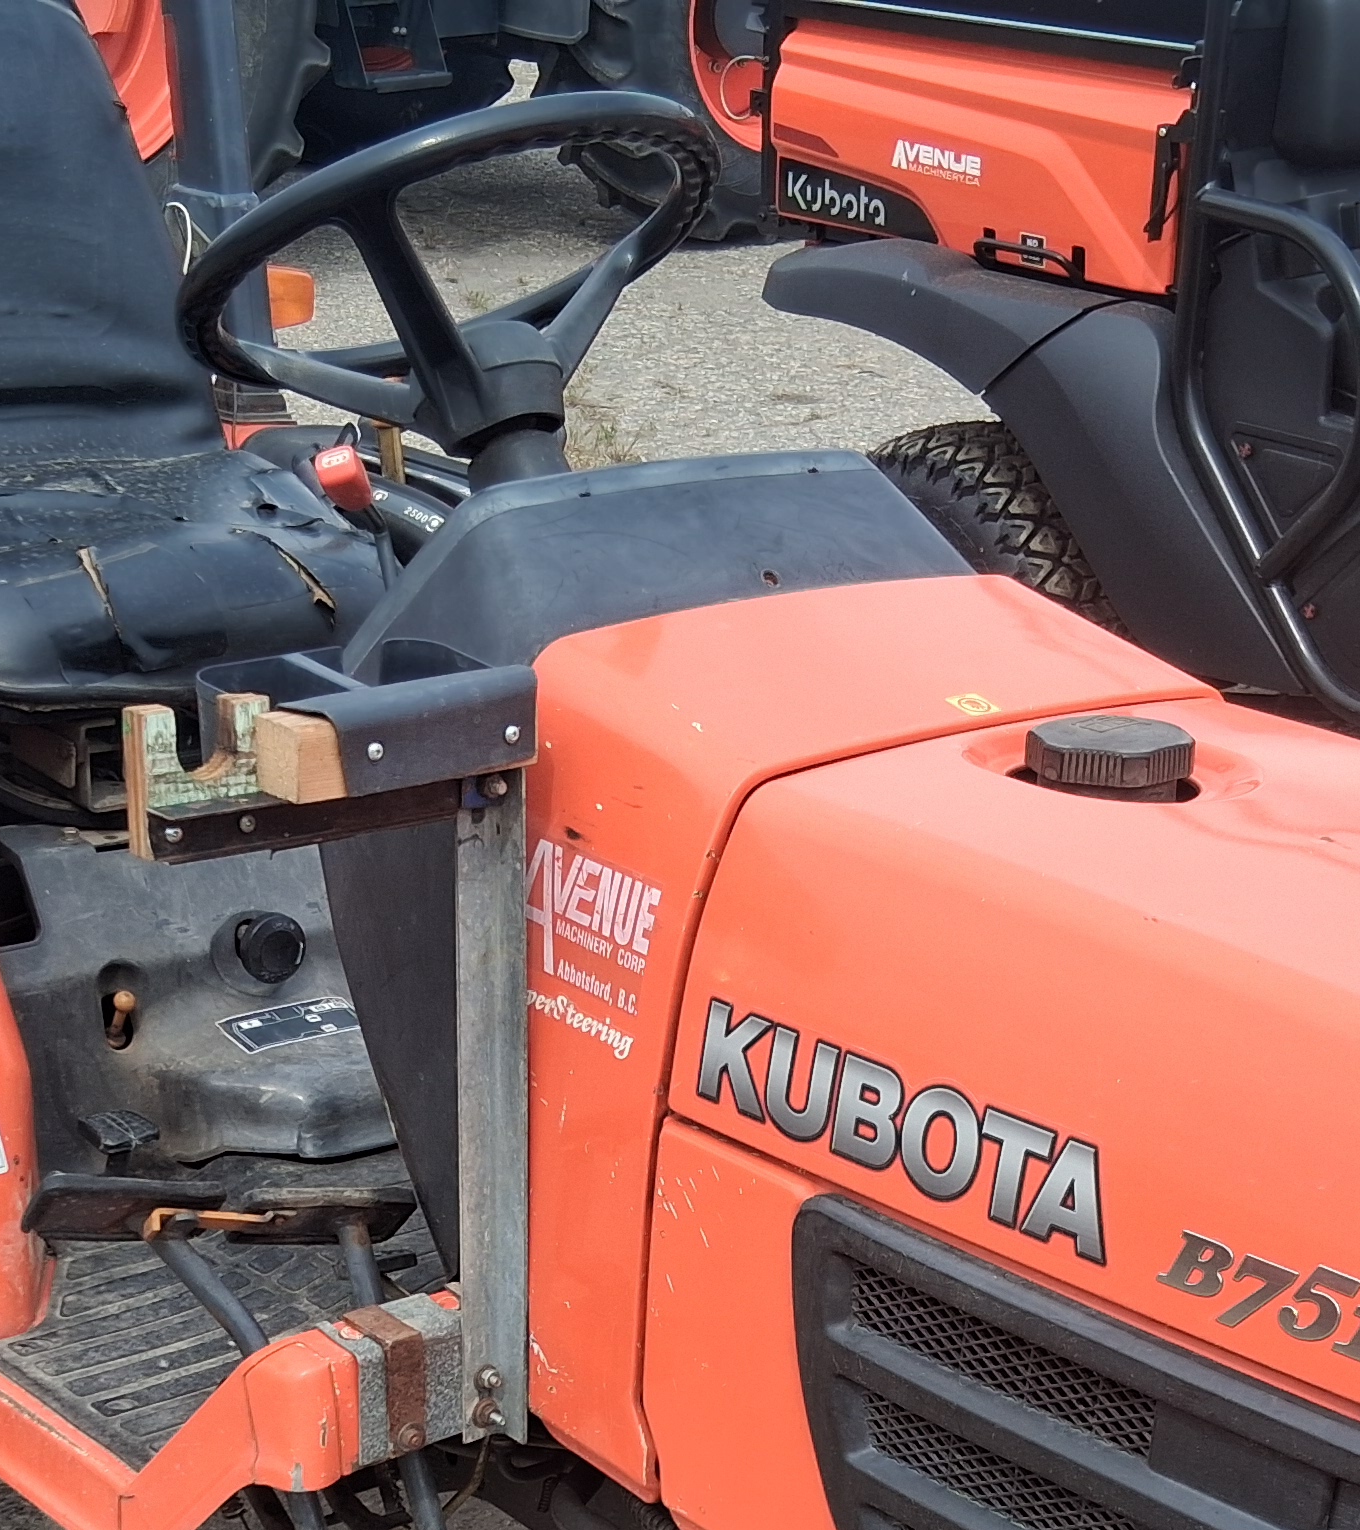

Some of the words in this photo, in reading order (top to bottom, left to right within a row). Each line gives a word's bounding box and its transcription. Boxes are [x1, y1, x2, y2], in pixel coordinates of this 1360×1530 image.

[891, 139, 981, 176] AVENUE
[908, 163, 981, 187] MACHINERY.CA
[787, 171, 886, 226] Kubota
[403, 506, 429, 523] 2500
[525, 838, 662, 976] AVENUE
[555, 918, 614, 960] MACHINERY
[617, 988, 638, 1016] B.C.
[696, 996, 1107, 1267] KUBOTA
